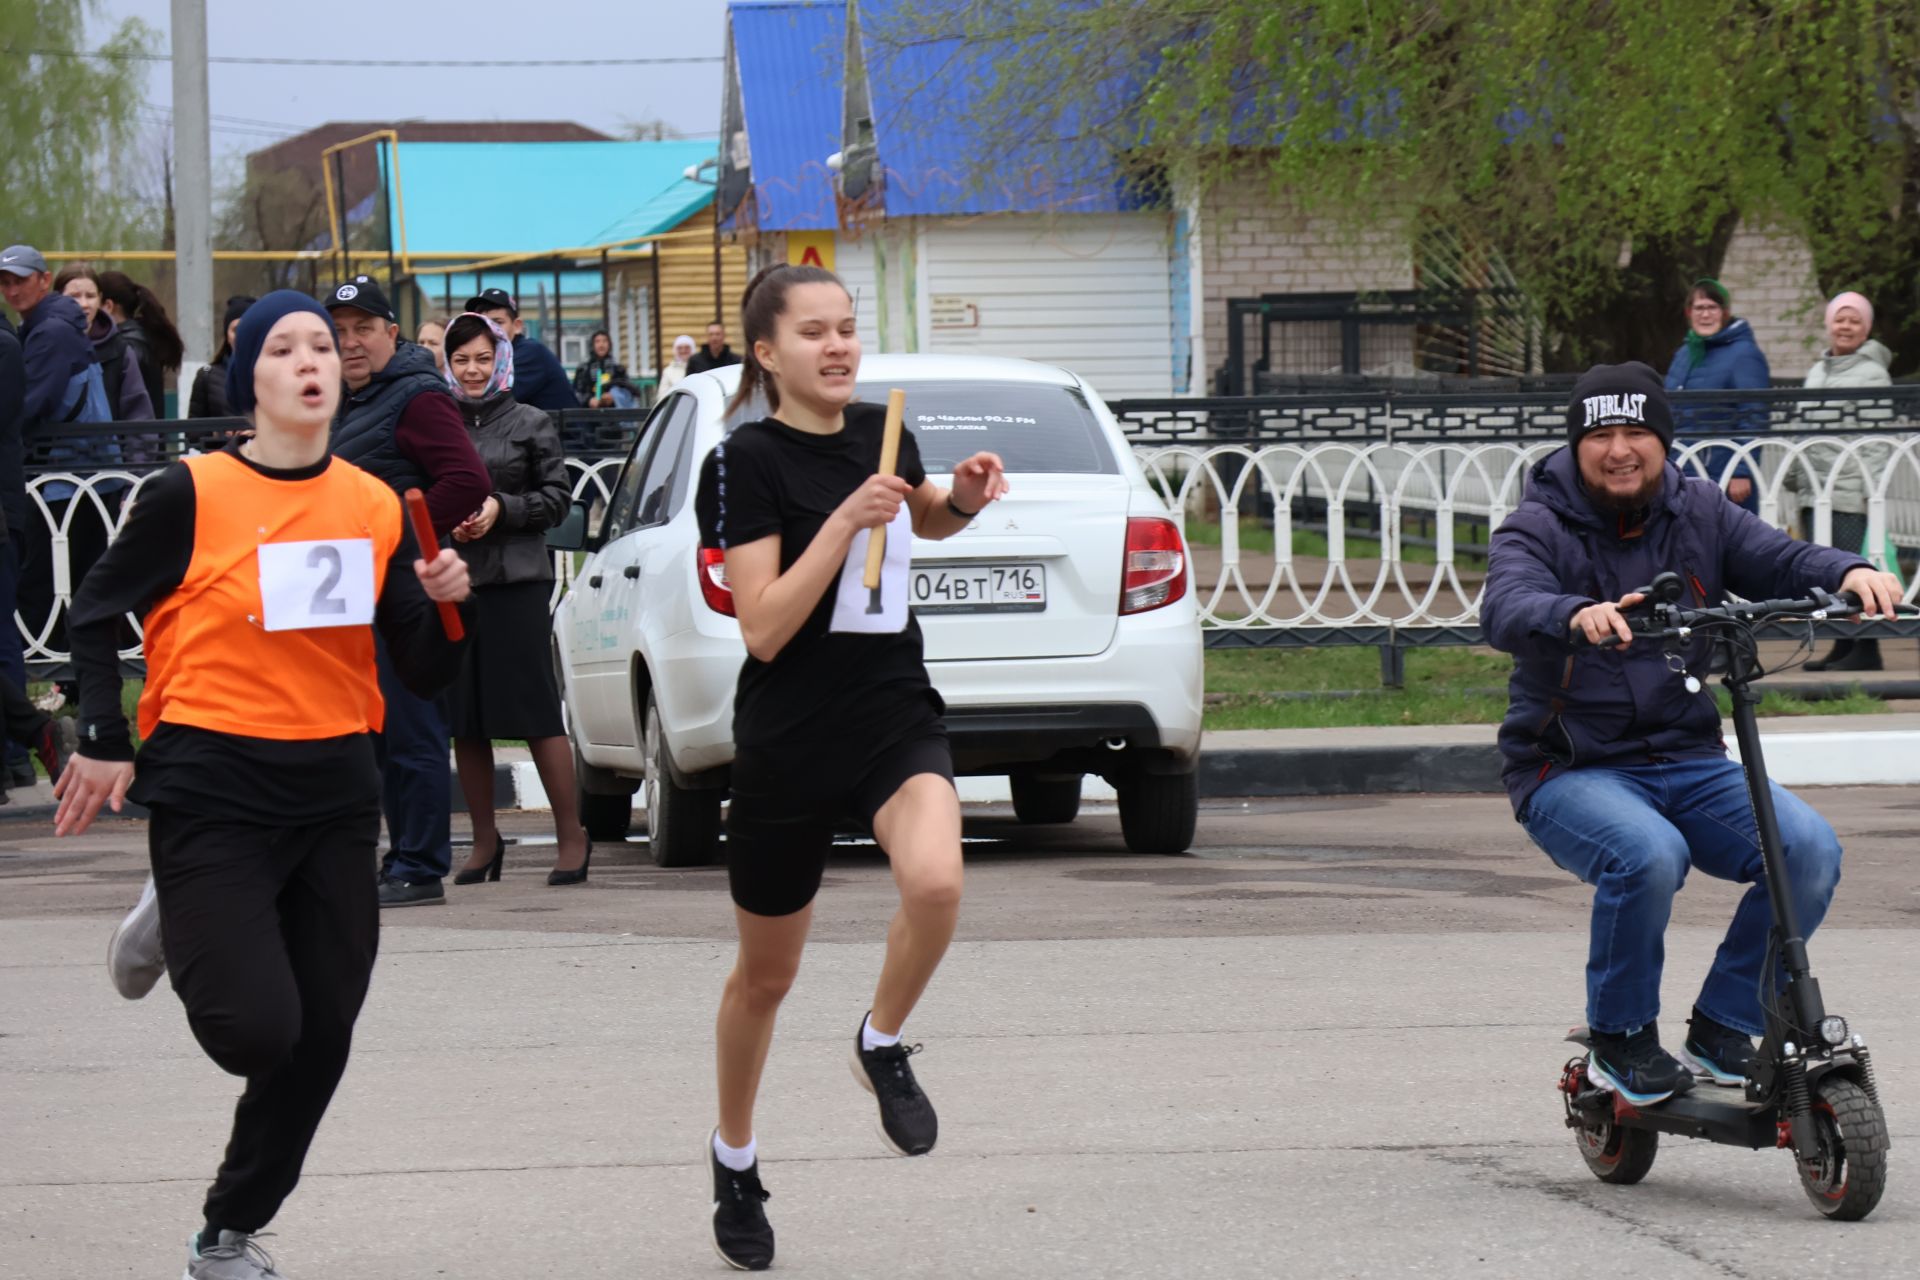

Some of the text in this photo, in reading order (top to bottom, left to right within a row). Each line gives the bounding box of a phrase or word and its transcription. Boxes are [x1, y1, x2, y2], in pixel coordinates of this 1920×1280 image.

[917, 415, 936, 423] Яр
[984, 415, 1014, 423] 90.2
[1016, 417, 1036, 425] FM
[1582, 393, 1647, 427] EVERLAST
[306, 545, 346, 615] 2
[908, 569, 1036, 601] 04ВТ 716
